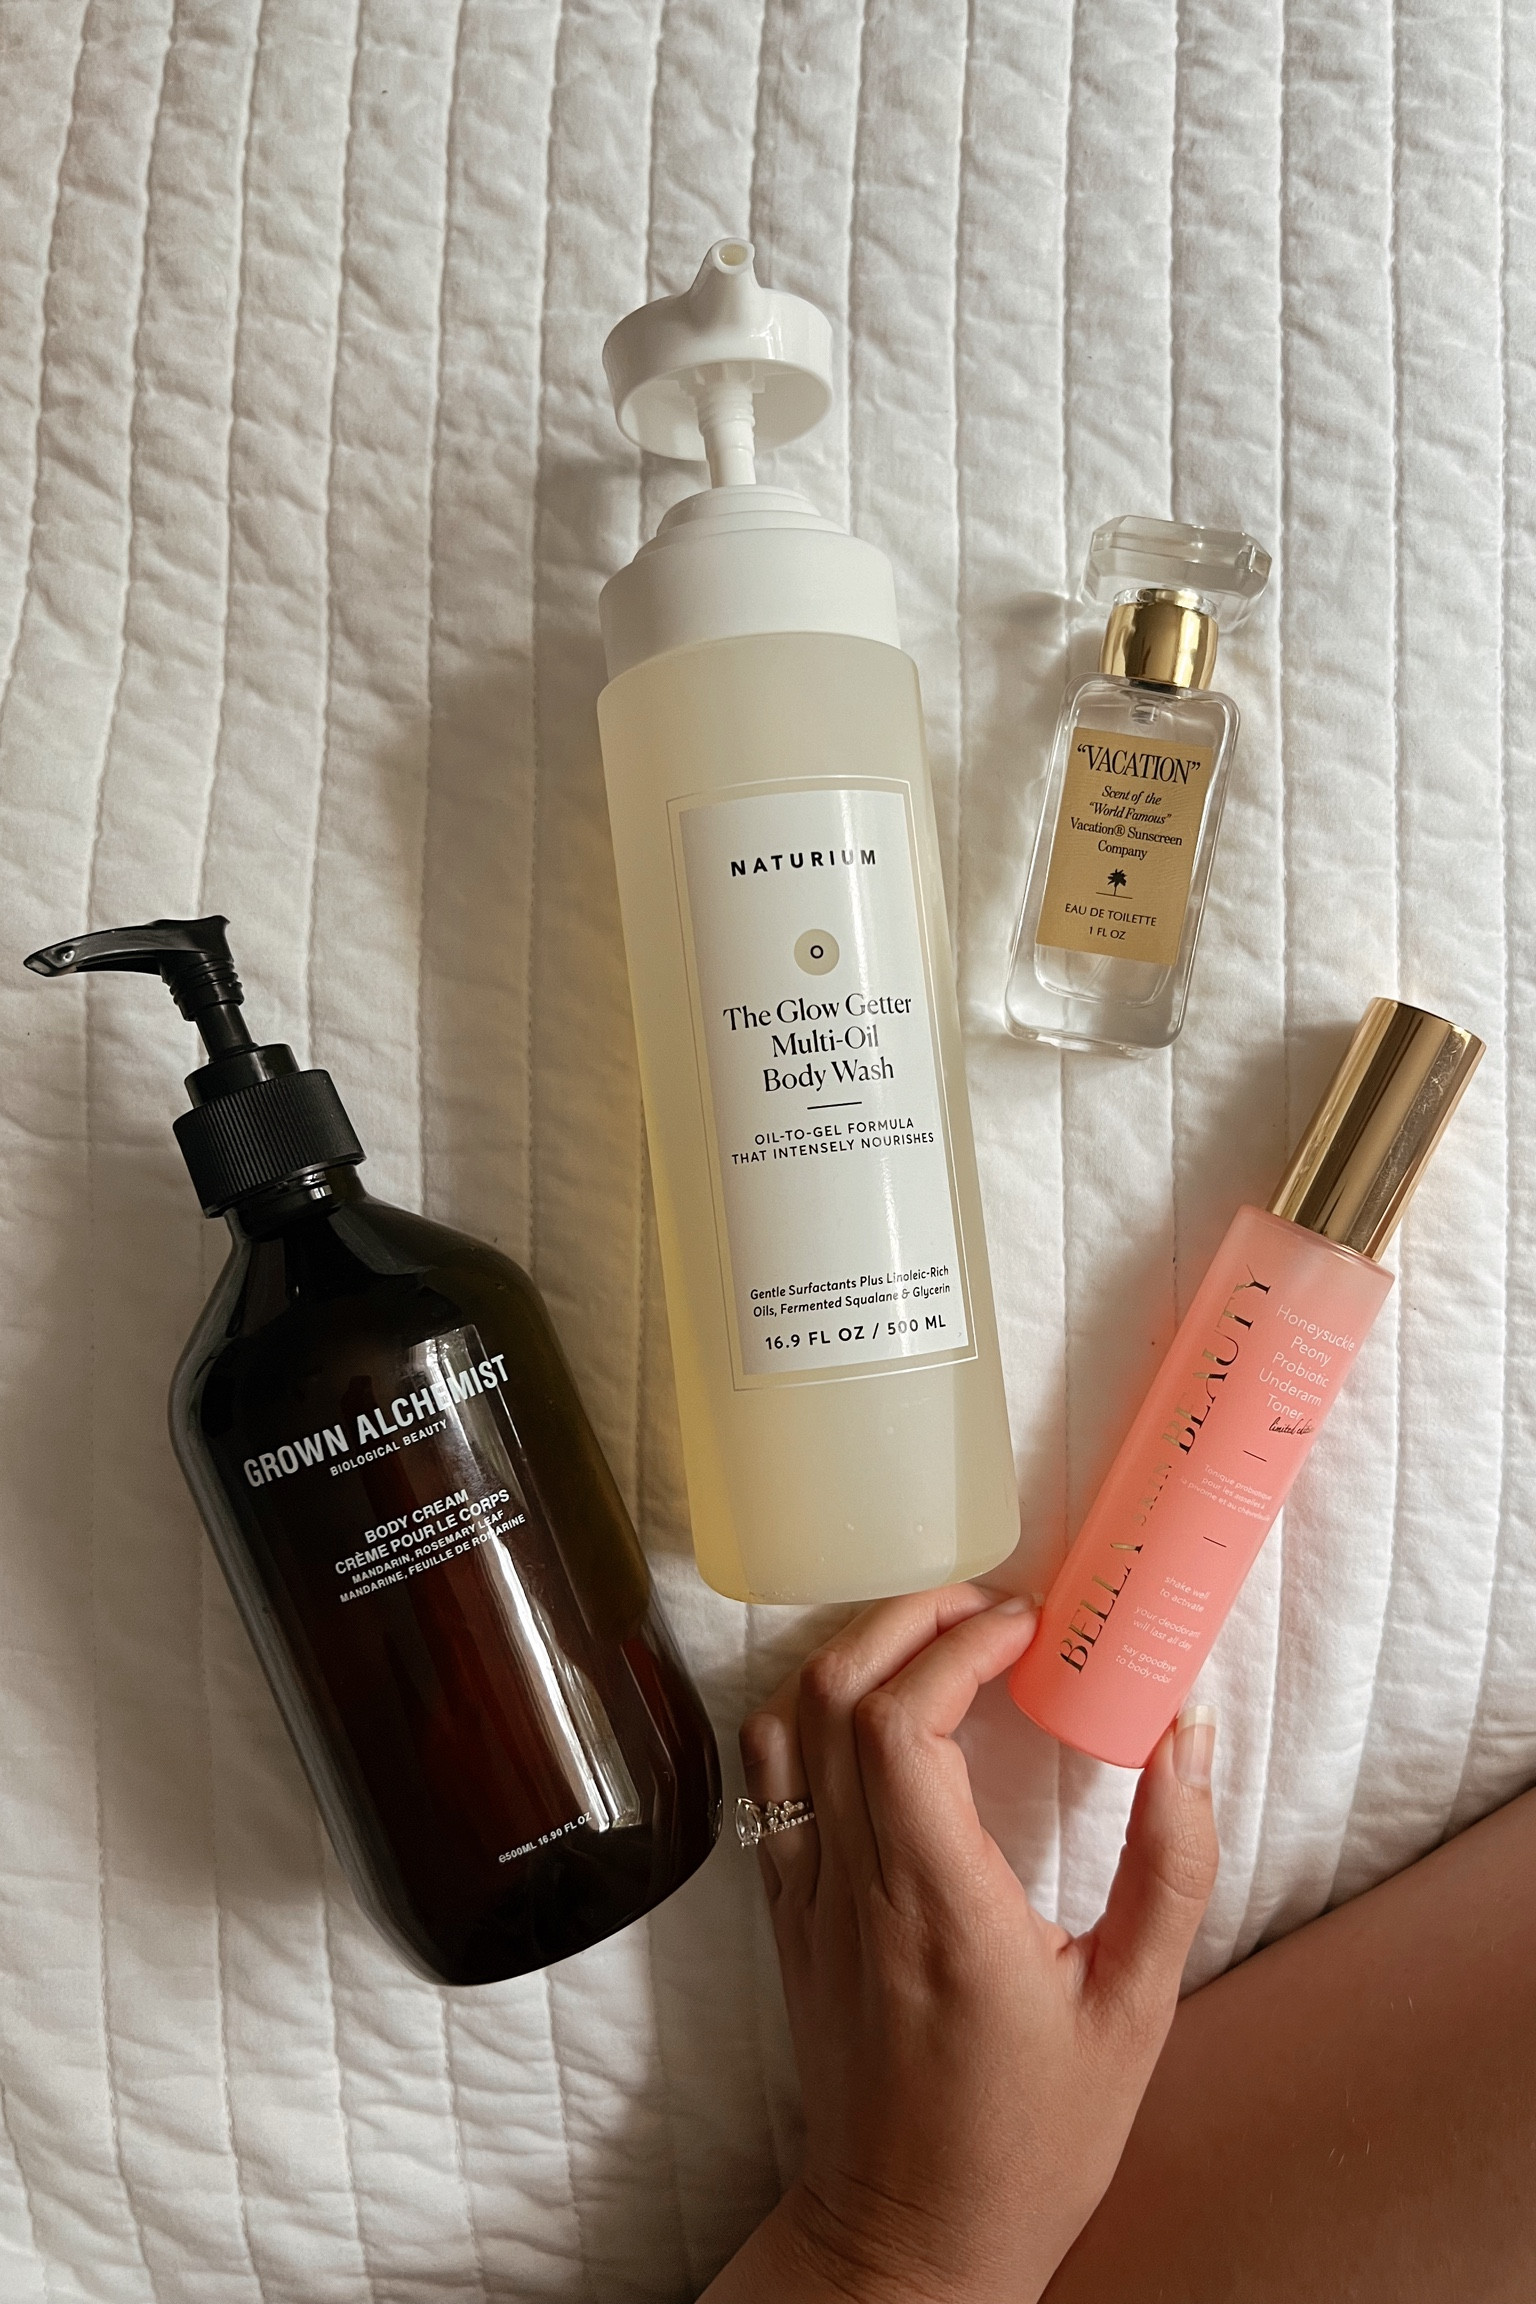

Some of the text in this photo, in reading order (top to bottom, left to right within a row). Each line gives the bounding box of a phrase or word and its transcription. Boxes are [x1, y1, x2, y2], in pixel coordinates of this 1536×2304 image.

[1077, 744, 1200, 784] “VACATION”
[1102, 786, 1162, 805] Scent of the
[1089, 802, 1172, 825] “World Famous”
[1071, 817, 1182, 846] Vacation® Sunscreen
[731, 849, 876, 876] NATURIUM
[1098, 840, 1147, 860] Company
[1065, 903, 1157, 926] EAU DE TOILETTE
[1089, 926, 1126, 940] 1 FL OZ
[723, 993, 912, 1031] The Glow Getter
[771, 1025, 879, 1057] Multi-Oil
[763, 1057, 894, 1092] Body Wash
[755, 1118, 914, 1145] OIL-TO-GEL FORMULA
[732, 1132, 934, 1165] THAT INTENSELY NOURISHES
[751, 1265, 949, 1300] Gentle Surfactants Plus Linoleic-Rich
[753, 1283, 950, 1317] Oils, Fermented Squalane & Glycerin
[765, 1315, 946, 1349] 16.9 FL OZ / 500 ML
[1276, 1304, 1355, 1352] Honeysuckle
[1291, 1336, 1332, 1367] Peony
[1272, 1352, 1329, 1388] Probiotic
[1259, 1367, 1322, 1407] Underarm
[243, 1354, 509, 1487] GROWN ALCHEMIST
[1266, 1393, 1303, 1420] Toner
[330, 1419, 448, 1476] BIOLOGICAL BEAUTY
[1059, 1543, 1144, 1674] BELLA
[1162, 1264, 1272, 1455] BEAUTY
[1205, 1463, 1234, 1485] Tonique
[1202, 1478, 1221, 1489] pour
[1223, 1487, 1233, 1496] les
[335, 1489, 510, 1574] CRÈME POUR LE CORPS
[364, 1489, 469, 1543] BODY CREAM
[352, 1510, 504, 1584] MANDARIN, ROSEMARY LEAF
[340, 1572, 408, 1603] MANDARINE,
[409, 1548, 454, 1575] FEUILLE
[455, 1541, 471, 1554] DE
[1165, 1576, 1211, 1600] shake well
[1134, 1606, 1157, 1620] your
[1160, 1588, 1205, 1612] to activate
[1133, 1619, 1192, 1652] will last all day
[1116, 1655, 1172, 1683] to body odor
[1122, 1644, 1177, 1672] say goodbye
[538, 1829, 562, 1846] 16.90
[564, 1821, 577, 1833] FL
[577, 1812, 592, 1825] OZ
